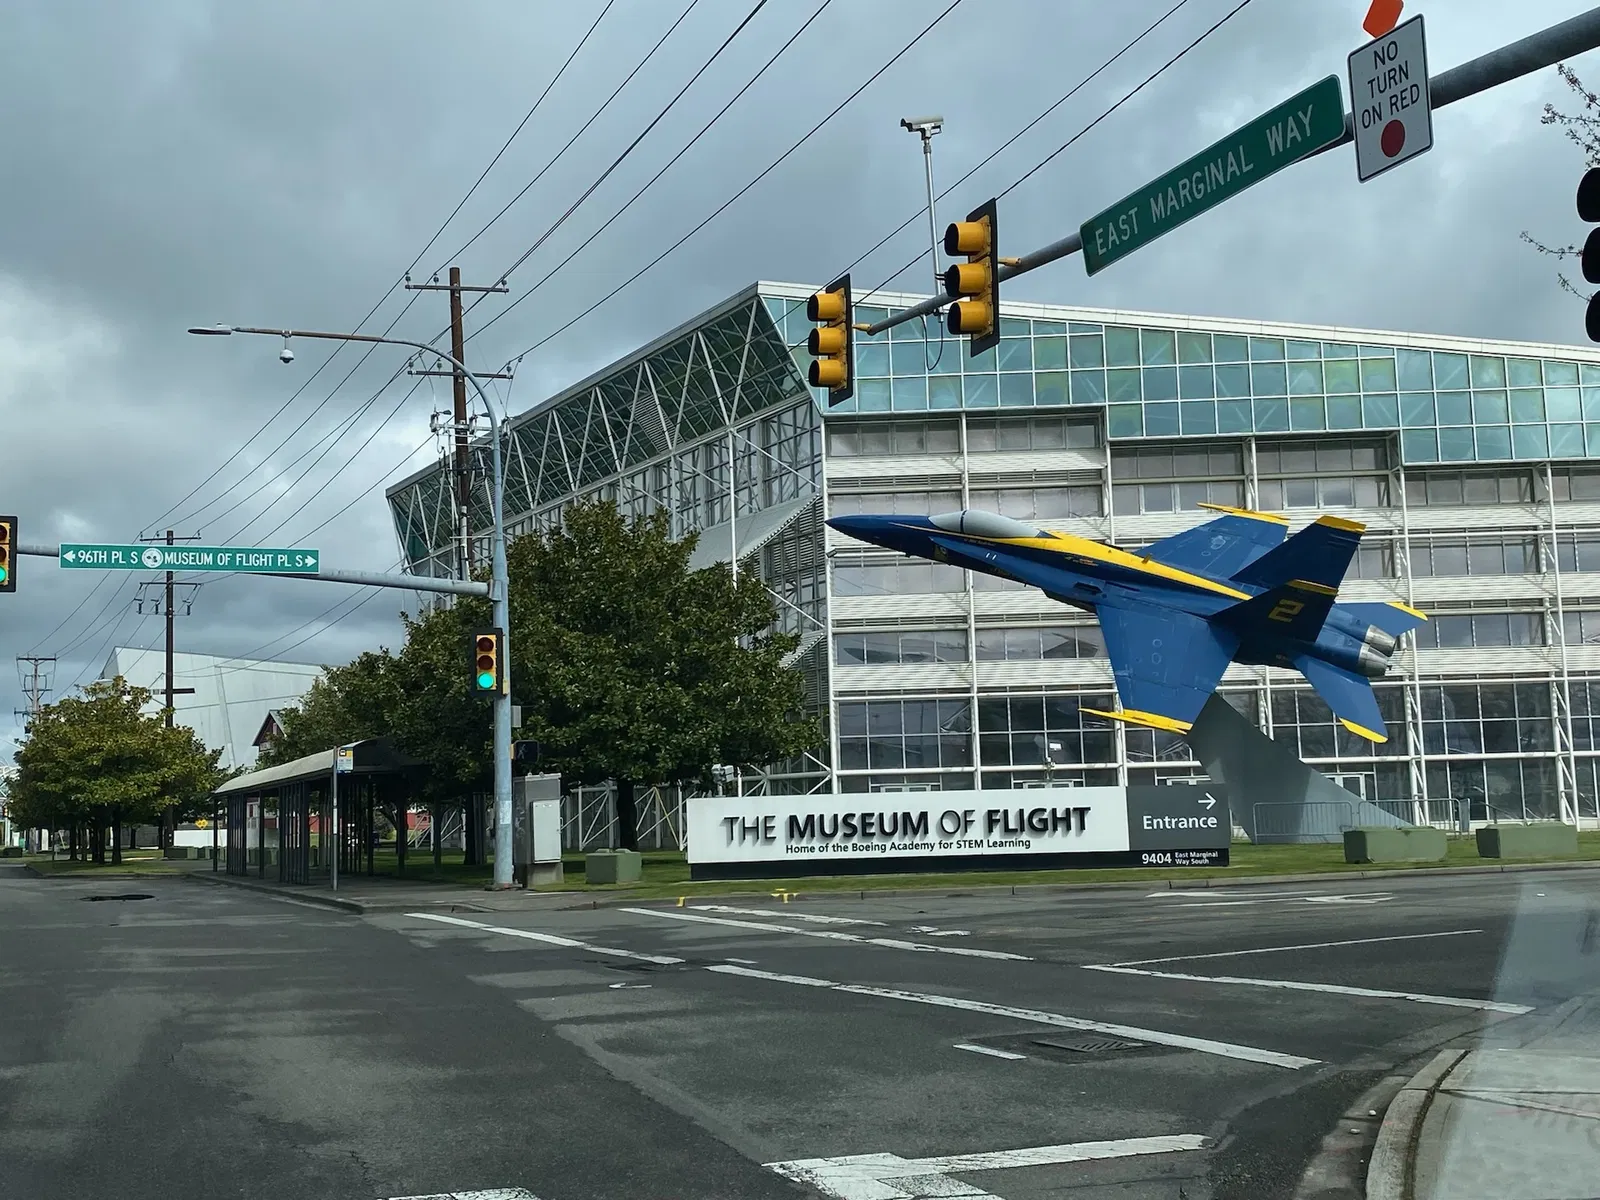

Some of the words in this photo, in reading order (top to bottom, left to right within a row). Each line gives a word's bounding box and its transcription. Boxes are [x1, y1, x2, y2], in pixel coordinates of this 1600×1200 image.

[1374, 41, 1398, 70] NO
[1368, 60, 1409, 98] TURN
[1362, 102, 1382, 129] ON
[1390, 83, 1420, 116] RED
[1095, 207, 1138, 255] EAST
[1150, 145, 1254, 223] MARGINAL
[1266, 104, 1313, 156] WAY
[78, 550, 107, 563] 96TH
[111, 551, 126, 564] PL
[130, 551, 138, 564] S
[164, 552, 212, 565] MUSEUM
[217, 553, 232, 565] OF
[236, 553, 273, 567] FLIGHT
[277, 554, 291, 567] PL
[295, 554, 303, 567] S
[1268, 599, 1305, 623] 2
[723, 815, 776, 840] THE
[788, 811, 929, 839] MUSEUM
[940, 809, 975, 834] OF
[987, 806, 1091, 833] FLIGHT
[1143, 815, 1218, 830] Entrance
[786, 844, 816, 854] Home
[818, 843, 829, 853] of
[832, 842, 849, 852] the
[852, 842, 887, 854] Boeing
[890, 840, 935, 852] Academy
[938, 840, 953, 849] for
[956, 839, 984, 849] STEM
[987, 837, 1031, 849] Learning
[1190, 851, 1219, 859] Marginal
[1142, 852, 1172, 864] 9404
